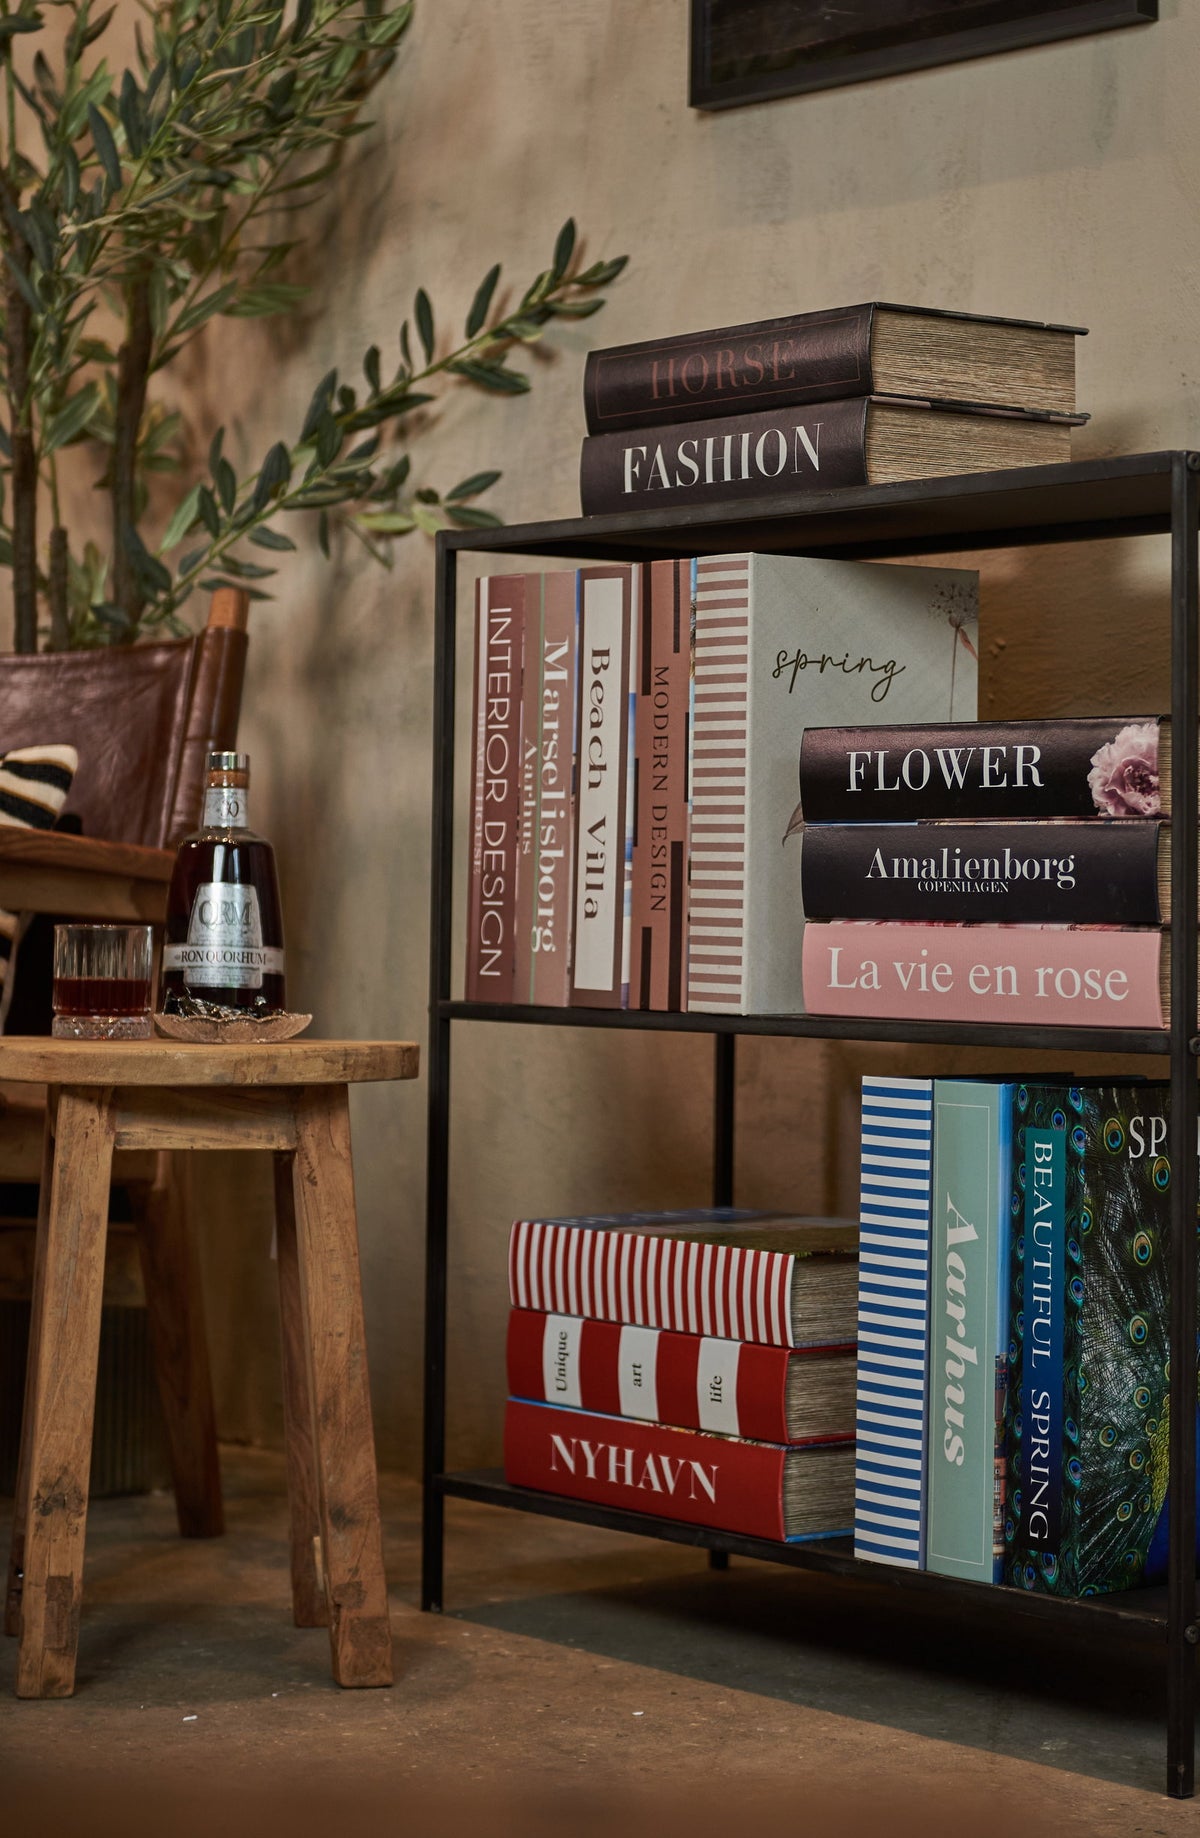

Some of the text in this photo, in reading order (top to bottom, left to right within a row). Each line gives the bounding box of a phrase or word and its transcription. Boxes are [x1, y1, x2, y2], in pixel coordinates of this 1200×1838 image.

[649, 339, 796, 400] HORSE
[622, 423, 825, 494] FASHION
[772, 648, 907, 702] spring
[479, 607, 512, 977] INTERIOR DESIGN
[522, 737, 539, 855] Aarhus
[531, 636, 569, 953] Marselisborg
[584, 647, 611, 920] Beach Villa
[650, 666, 669, 912] MODERN DESIGN
[846, 745, 1045, 792] FLOWER
[865, 847, 1076, 889] Amalienborg
[917, 881, 1010, 893] COPENHAGEN
[181, 950, 267, 966] RON QUORHUM
[827, 947, 1130, 1001] La vie en rose
[943, 1191, 980, 1468] Aarhus
[1028, 1140, 1054, 1541] BEAUTIFUL SPRING
[555, 1330, 569, 1392] Unique
[632, 1362, 643, 1388] art
[710, 1374, 723, 1404] life
[550, 1434, 720, 1504] NYHAVN
